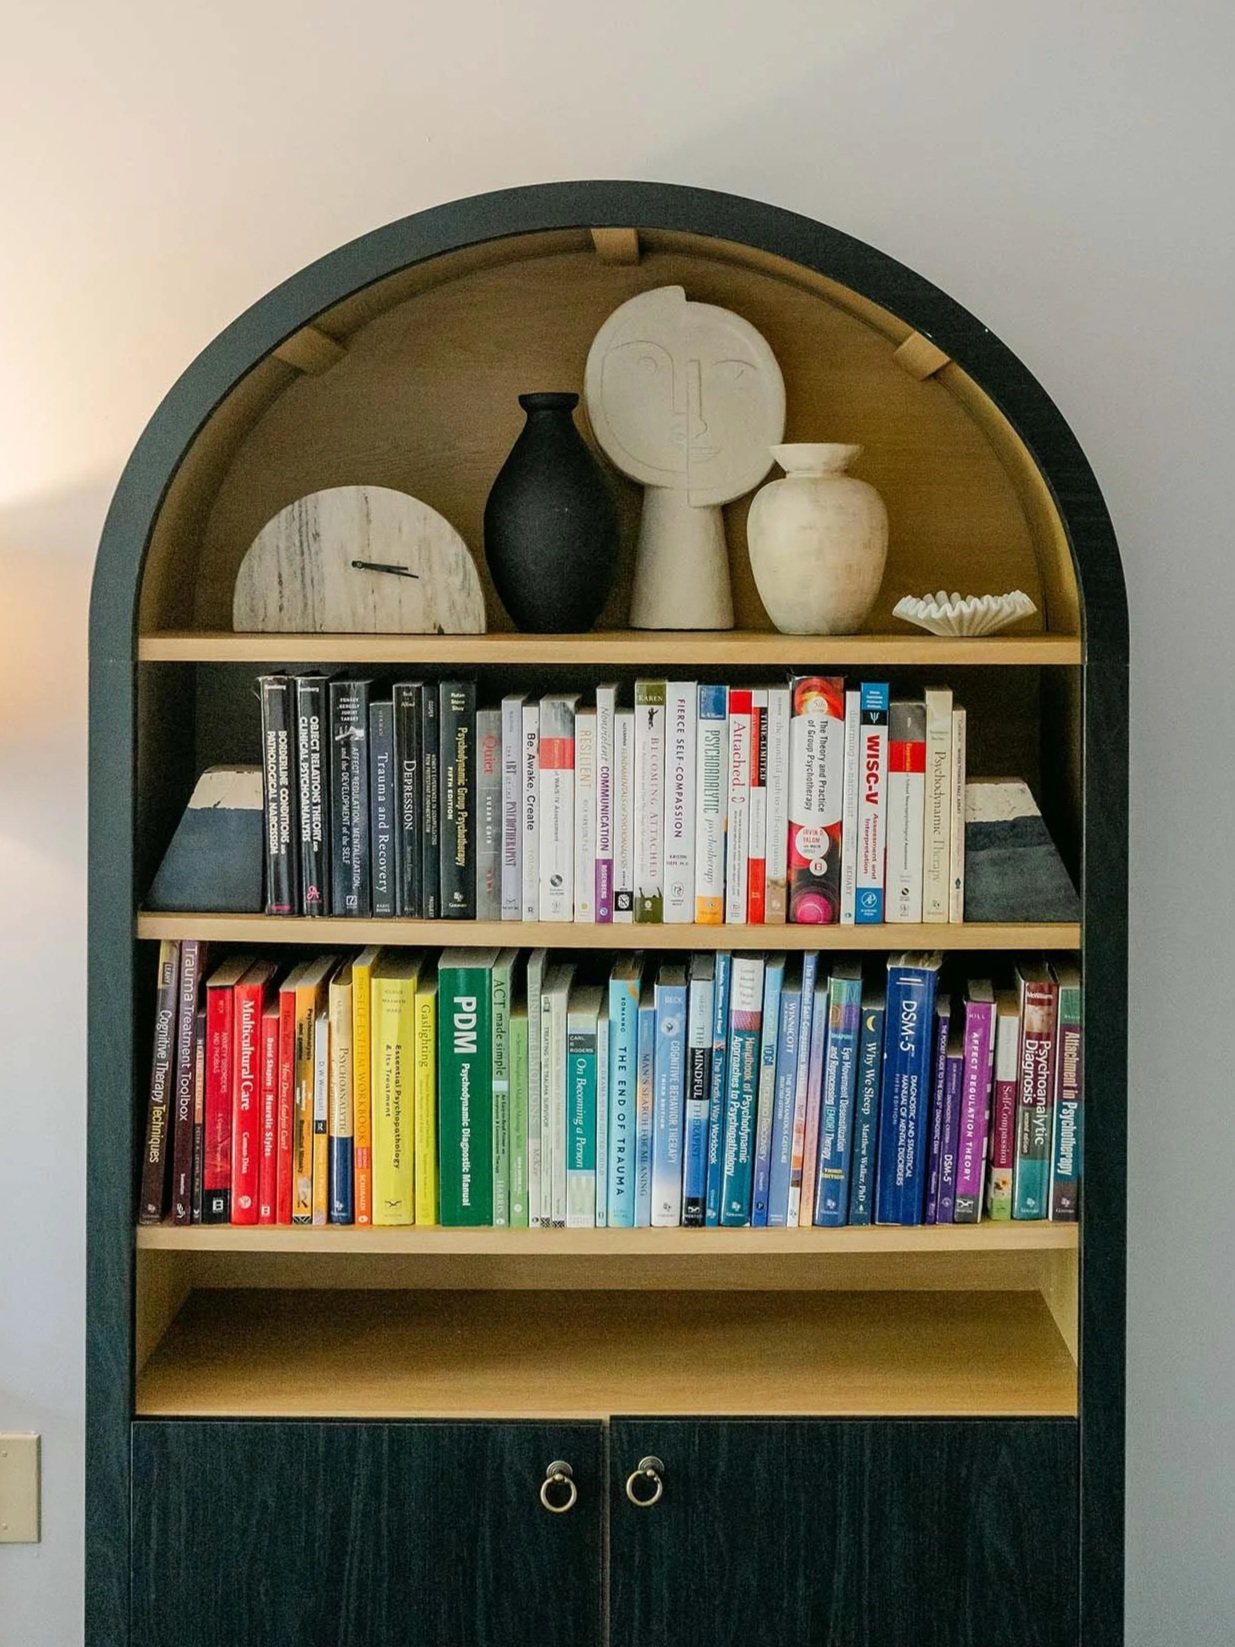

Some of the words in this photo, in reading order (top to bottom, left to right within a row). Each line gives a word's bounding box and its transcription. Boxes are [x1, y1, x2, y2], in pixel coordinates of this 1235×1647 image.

[299, 716, 309, 760] CLINICAL
[311, 716, 320, 751] OBJECT
[600, 706, 612, 762] Nonviolent
[676, 699, 686, 734] FIERCE
[807, 719, 816, 728] of
[819, 719, 829, 734] The
[278, 730, 288, 786] BORDERLINE
[351, 747, 360, 774] AFFECT
[456, 727, 468, 786] Psychodynamic
[482, 735, 498, 775] Quiet
[580, 729, 592, 788] RESILIENT
[732, 720, 747, 792] Attached.
[759, 713, 768, 781] TIME-LIMITED
[805, 729, 816, 753] Group
[817, 736, 829, 761] Theory
[266, 730, 277, 799] PATHOLOGICAL
[311, 753, 322, 803] RELATIONS
[377, 752, 389, 802] Trauma
[650, 737, 660, 805] BECOMING
[703, 729, 721, 814] PSYCHOANALYTIC
[804, 754, 815, 811] Psychotherapy
[819, 764, 828, 778] and
[864, 735, 881, 805] WISC-V
[300, 762, 311, 842] PSYCHOANALYSIS
[341, 771, 351, 826] DEVELOPMENT
[403, 760, 416, 830] DEPRESSION
[456, 787, 468, 809] Group
[600, 766, 610, 852] COMMUNICATION
[674, 738, 685, 839] SELF-COMPASSION
[818, 780, 828, 813] Practice
[930, 751, 947, 836] Psychodynamic
[269, 802, 279, 855] NARCISSISM
[280, 787, 290, 844] CONDITIONS
[312, 805, 322, 842] THEORY
[377, 806, 389, 829] and
[504, 801, 518, 867] PSYCHOTHERAPIST
[526, 795, 536, 831] Create
[342, 846, 352, 865] SELF
[455, 811, 468, 867] Psychotherapy
[649, 811, 660, 877] ATTACHED
[704, 818, 719, 886] psychotherapy
[862, 818, 872, 875] Interpretation
[871, 813, 880, 862] Assessment
[376, 834, 389, 894] Recovery
[871, 864, 880, 880] and
[928, 839, 946, 882] Therapy
[184, 944, 198, 1000] Trauma
[493, 979, 505, 1009] ACT
[156, 1009, 172, 1059] Cognitive
[181, 1004, 195, 1069] Treatment
[242, 1000, 255, 1079] Multicultural
[305, 1008, 314, 1061] Psychoanalysis
[418, 1004, 431, 1068] Gaslighting
[453, 996, 477, 1054] PDM
[495, 1013, 505, 1040] made
[785, 1001, 797, 1055] WINNICOTT
[494, 1042, 505, 1077] simple
[577, 1058, 587, 1075] On
[618, 1046, 627, 1071] THE
[642, 1053, 650, 1086] MAN'S
[671, 1040, 680, 1084] COGNITIVE
[730, 1035, 743, 1088] Approaches
[744, 1036, 754, 1082] Handbook
[763, 1044, 774, 1067] YOGA
[829, 1045, 839, 1059] and
[841, 1047, 852, 1060] Eye
[863, 1042, 877, 1067] Why
[970, 1031, 980, 1070] AFFECT
[1022, 1039, 1038, 1104] Diagnosis
[1063, 1031, 1080, 1087] Attachment
[152, 1061, 169, 1103] Therapy
[265, 1059, 274, 1087] Shapiro
[339, 1047, 349, 1135] PSYCHOANALYTIC
[459, 1062, 470, 1127] Psychodynamic
[617, 1079, 626, 1106] END
[694, 1048, 704, 1099] MINDFUL
[713, 1073, 722, 1104] Mindful
[731, 1090, 739, 1099] to
[743, 1082, 753, 1093] of
[827, 1059, 838, 1105] Reprocessing
[839, 1061, 851, 1098] Movement
[864, 1069, 875, 1086] We
[900, 1073, 909, 1106] MANUAL
[1033, 1040, 1052, 1146] Psychoanalytic
[1063, 1089, 1079, 1099] in
[179, 1072, 192, 1121] Toolbox
[241, 1080, 254, 1111] Care
[264, 1094, 273, 1129] Neurotic
[358, 1071, 367, 1143] WORKBOOK
[573, 1077, 587, 1126] Becoming
[641, 1087, 650, 1126] SEARCH
[669, 1085, 679, 1126] BEHAVIOR
[710, 1104, 719, 1123] Way
[861, 1087, 874, 1115] Sleep
[900, 1106, 908, 1118] OF
[907, 1075, 918, 1119] DIAGNOSTIC
[966, 1073, 978, 1138] REGULATION
[147, 1104, 167, 1163] Techniques
[393, 1089, 402, 1169] Psychopathology
[617, 1112, 626, 1130] OF
[641, 1128, 649, 1148] FOR
[691, 1102, 702, 1159] THERAPIST
[725, 1101, 739, 1177] Psychopathology
[738, 1094, 752, 1164] Psychodynamic
[759, 1117, 772, 1162] Recovery
[824, 1105, 837, 1133] (EMDR)
[837, 1099, 849, 1152] Desensitization
[862, 1123, 870, 1156] Matthew
[898, 1118, 907, 1147] MENTAL
[907, 1120, 916, 1138] AND
[999, 1084, 1013, 1165] Self-Compassion
[1056, 1101, 1078, 1176] Psychotherapy
[263, 1131, 273, 1157] Styles
[460, 1128, 470, 1173] Diagnostic
[575, 1137, 587, 1168] Person
[667, 1128, 678, 1164] THERAPY
[710, 1123, 719, 1165] Workbook
[821, 1133, 834, 1161] Therapy
[905, 1138, 915, 1178] STATISTICAL
[963, 1142, 974, 1182] THEORY
[616, 1137, 626, 1196] TRAUMA
[639, 1149, 649, 1197] MEANING
[859, 1156, 868, 1184] Walker,
[895, 1147, 906, 1187] DISORDERS
[462, 1174, 470, 1206] Manual
[858, 1185, 867, 1202] PhD
